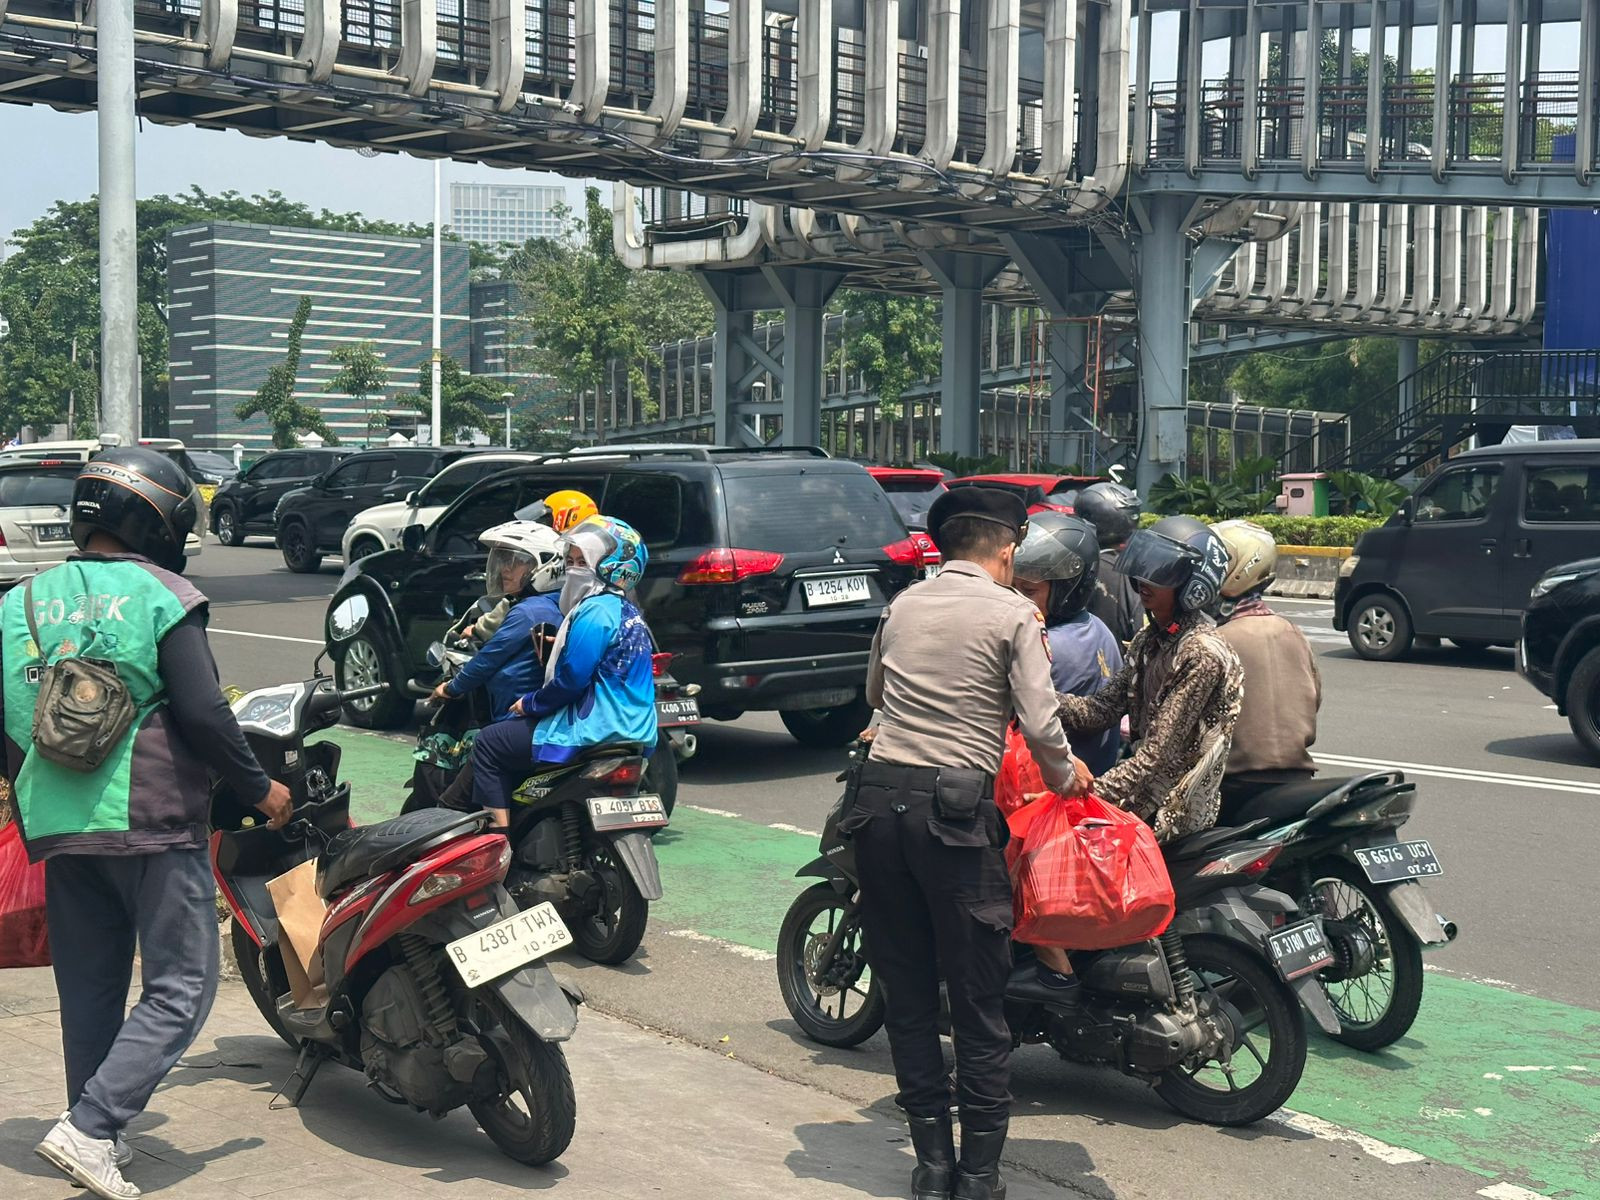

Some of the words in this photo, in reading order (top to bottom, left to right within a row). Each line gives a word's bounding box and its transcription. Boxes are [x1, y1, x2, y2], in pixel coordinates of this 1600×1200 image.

[82, 466, 140, 484] COOPY
[76, 500, 100, 509] HONDA
[550, 564, 566, 580] NH
[806, 583, 814, 596] B
[819, 581, 843, 595] 1254
[847, 576, 865, 592] KOY
[33, 599, 65, 626] GO
[594, 803, 602, 815] B
[610, 801, 634, 812] 4051
[826, 845, 845, 856] HONDA
[1357, 852, 1370, 866] B
[1370, 847, 1403, 864] 6676
[473, 908, 496, 919] HONDA
[452, 945, 468, 964] B
[479, 924, 518, 954] 4387
[521, 907, 558, 934] TWX
[1273, 940, 1283, 958] B
